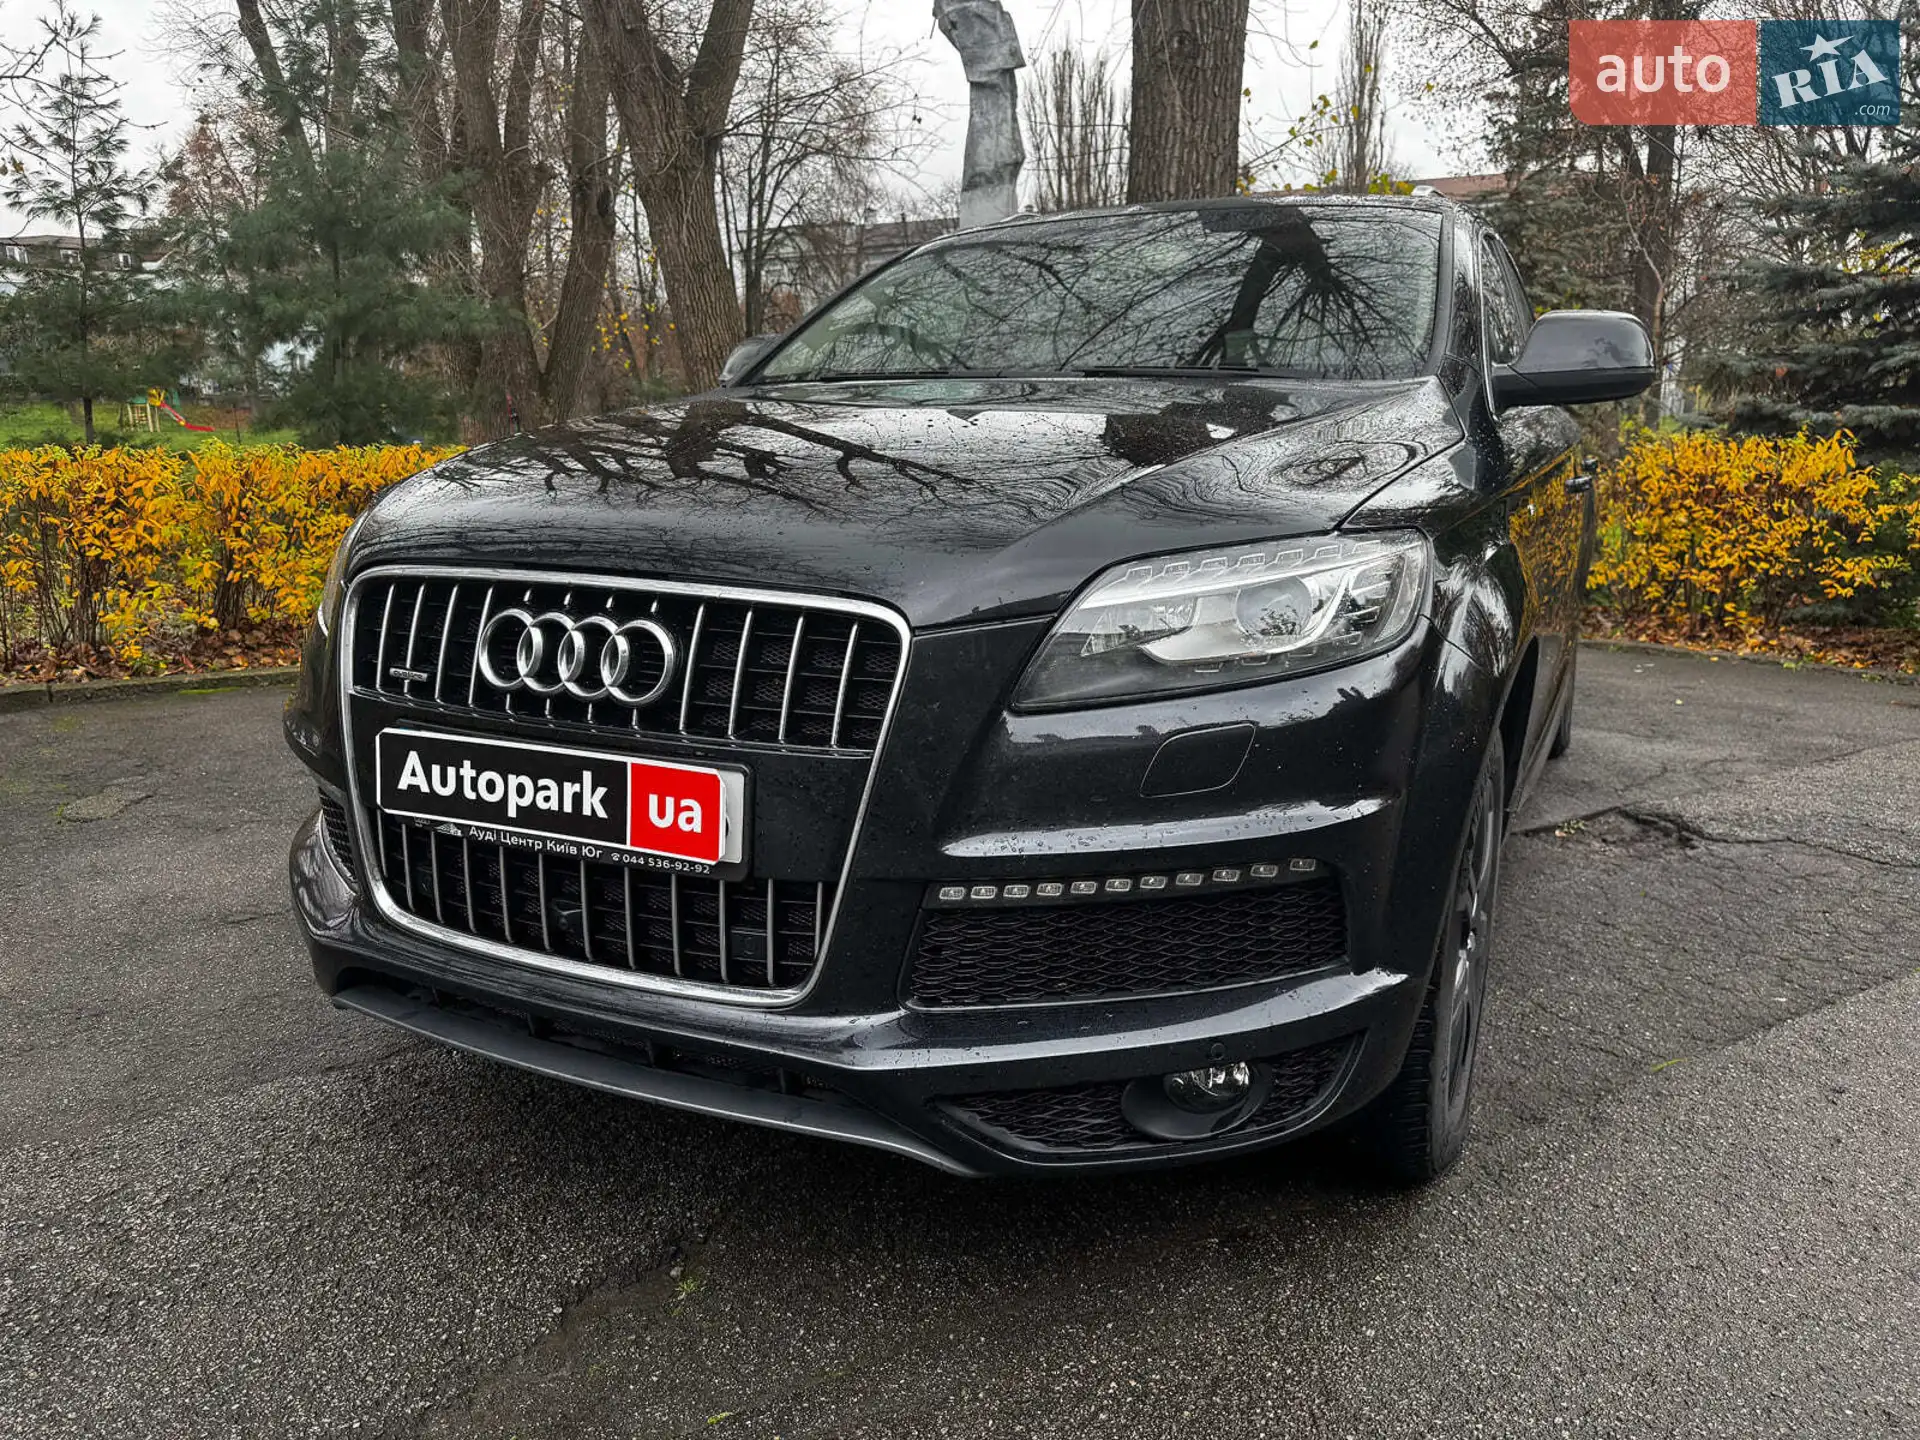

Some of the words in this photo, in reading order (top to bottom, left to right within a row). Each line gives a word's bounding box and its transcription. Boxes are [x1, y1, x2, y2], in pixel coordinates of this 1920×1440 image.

[396, 750, 608, 819] Autopark
[648, 794, 703, 834] ua
[468, 826, 497, 842] Ауді
[500, 832, 543, 852] Центр
[546, 839, 578, 855] Київ
[582, 846, 604, 859] Юг
[622, 853, 645, 865] 044
[648, 857, 710, 874] 536-92-92
